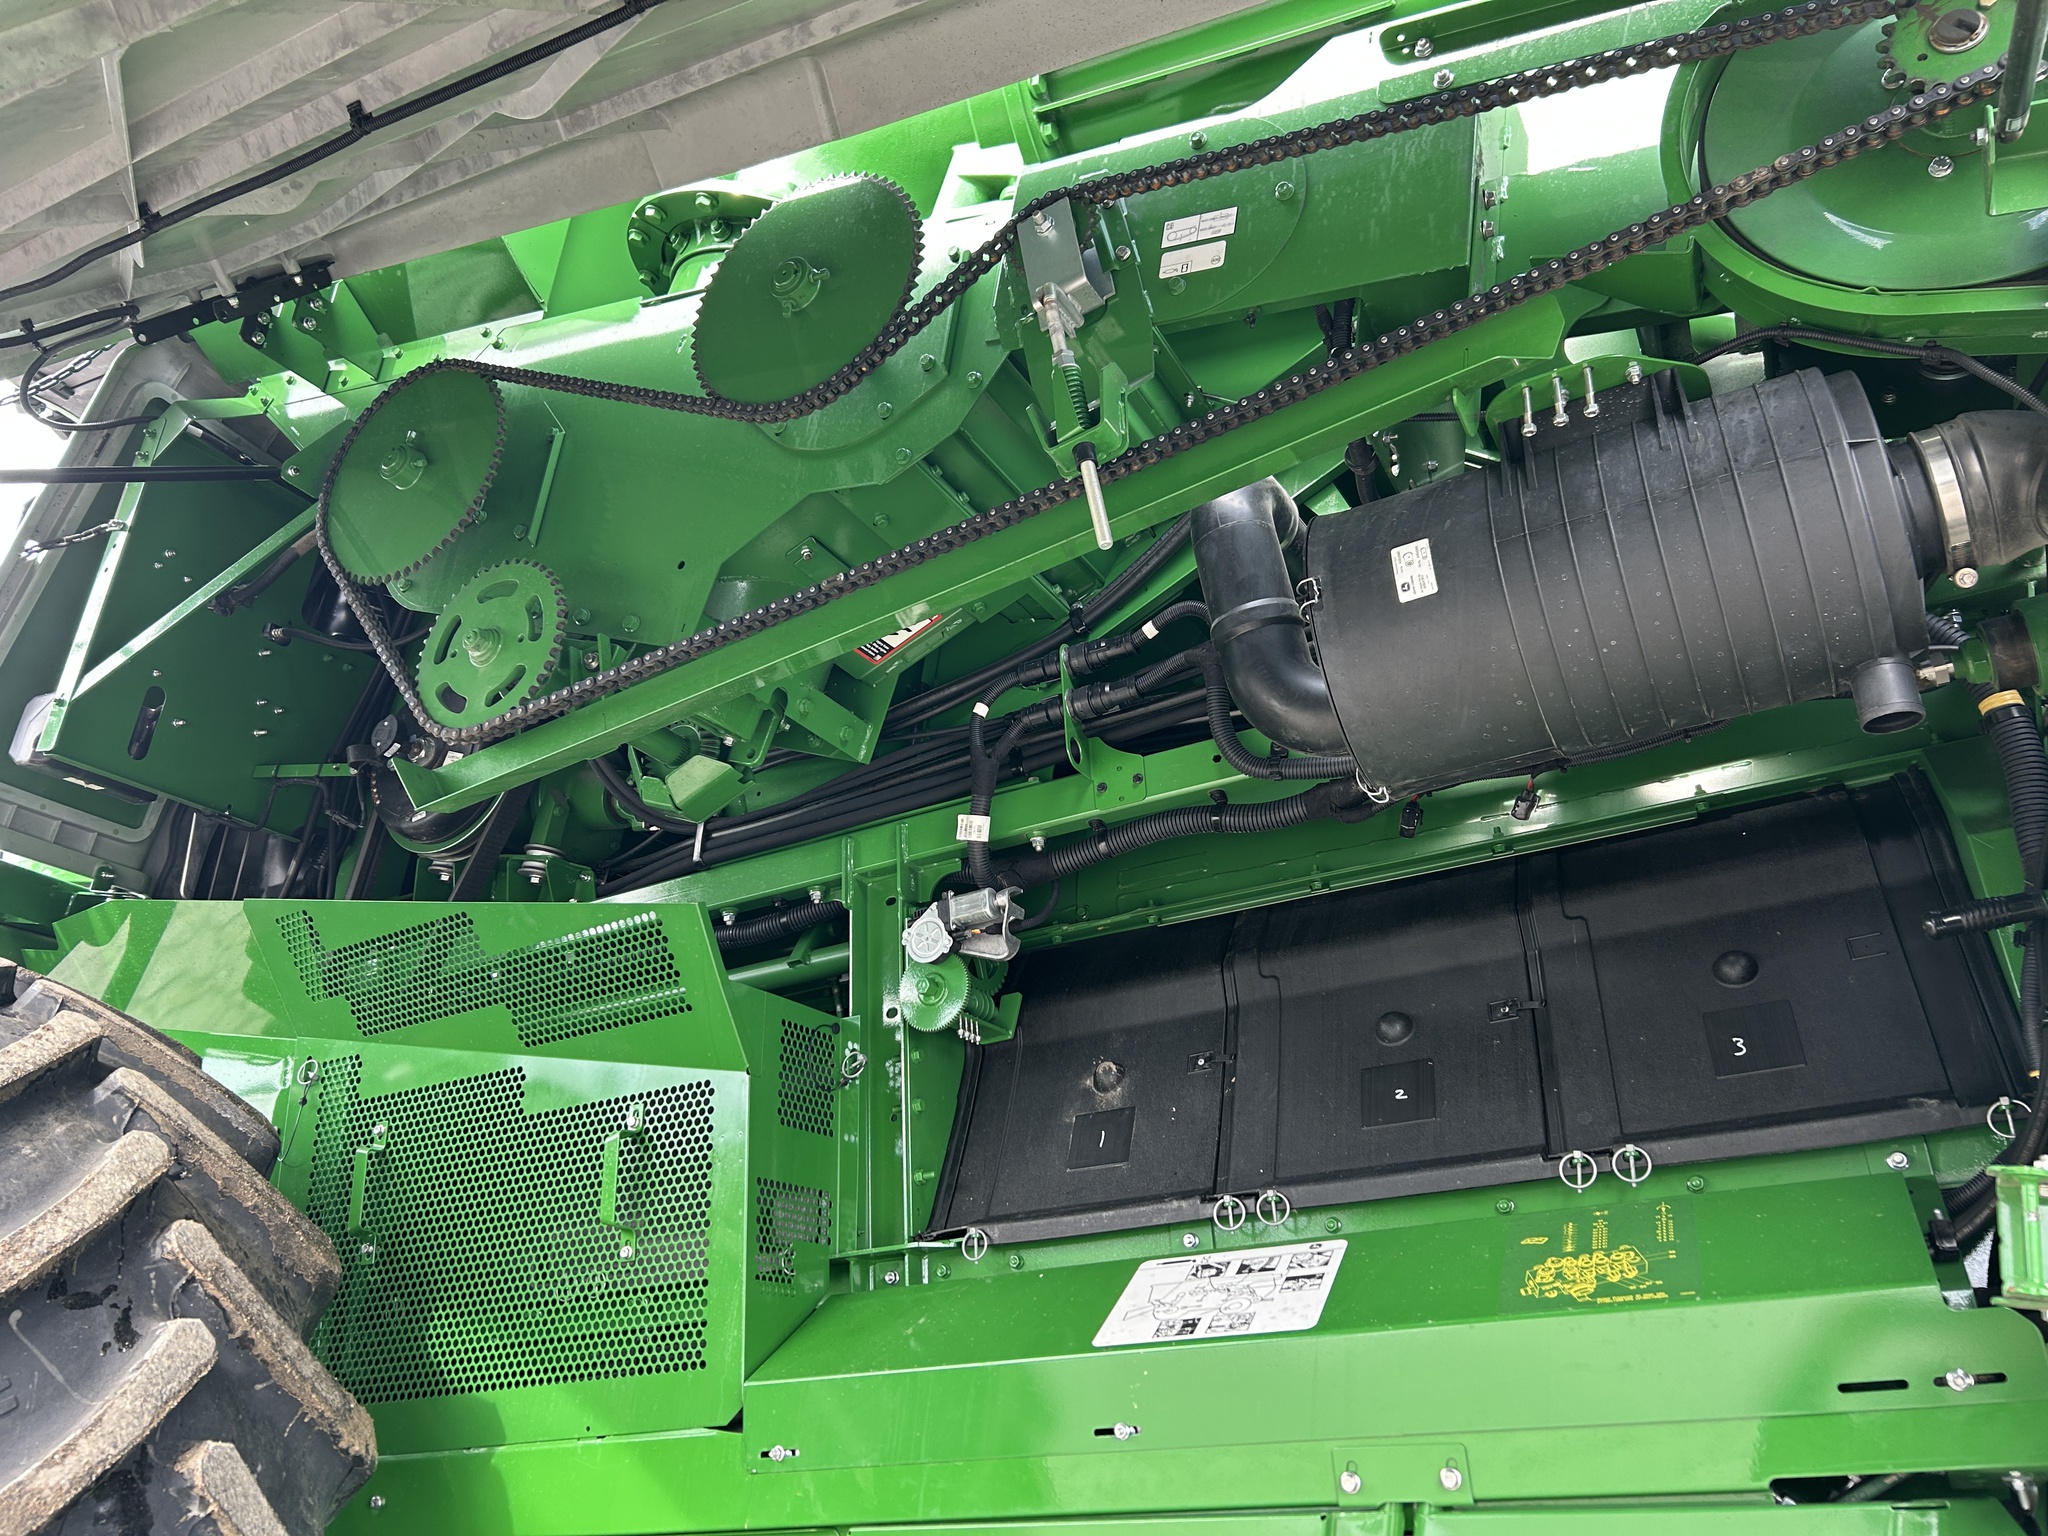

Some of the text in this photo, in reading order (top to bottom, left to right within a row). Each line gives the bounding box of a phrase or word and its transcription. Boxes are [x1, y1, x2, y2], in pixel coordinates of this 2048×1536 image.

[1731, 1037, 1747, 1057] 3
[1394, 1088, 1409, 1100] 2
[1099, 1130, 1106, 1148] 1
